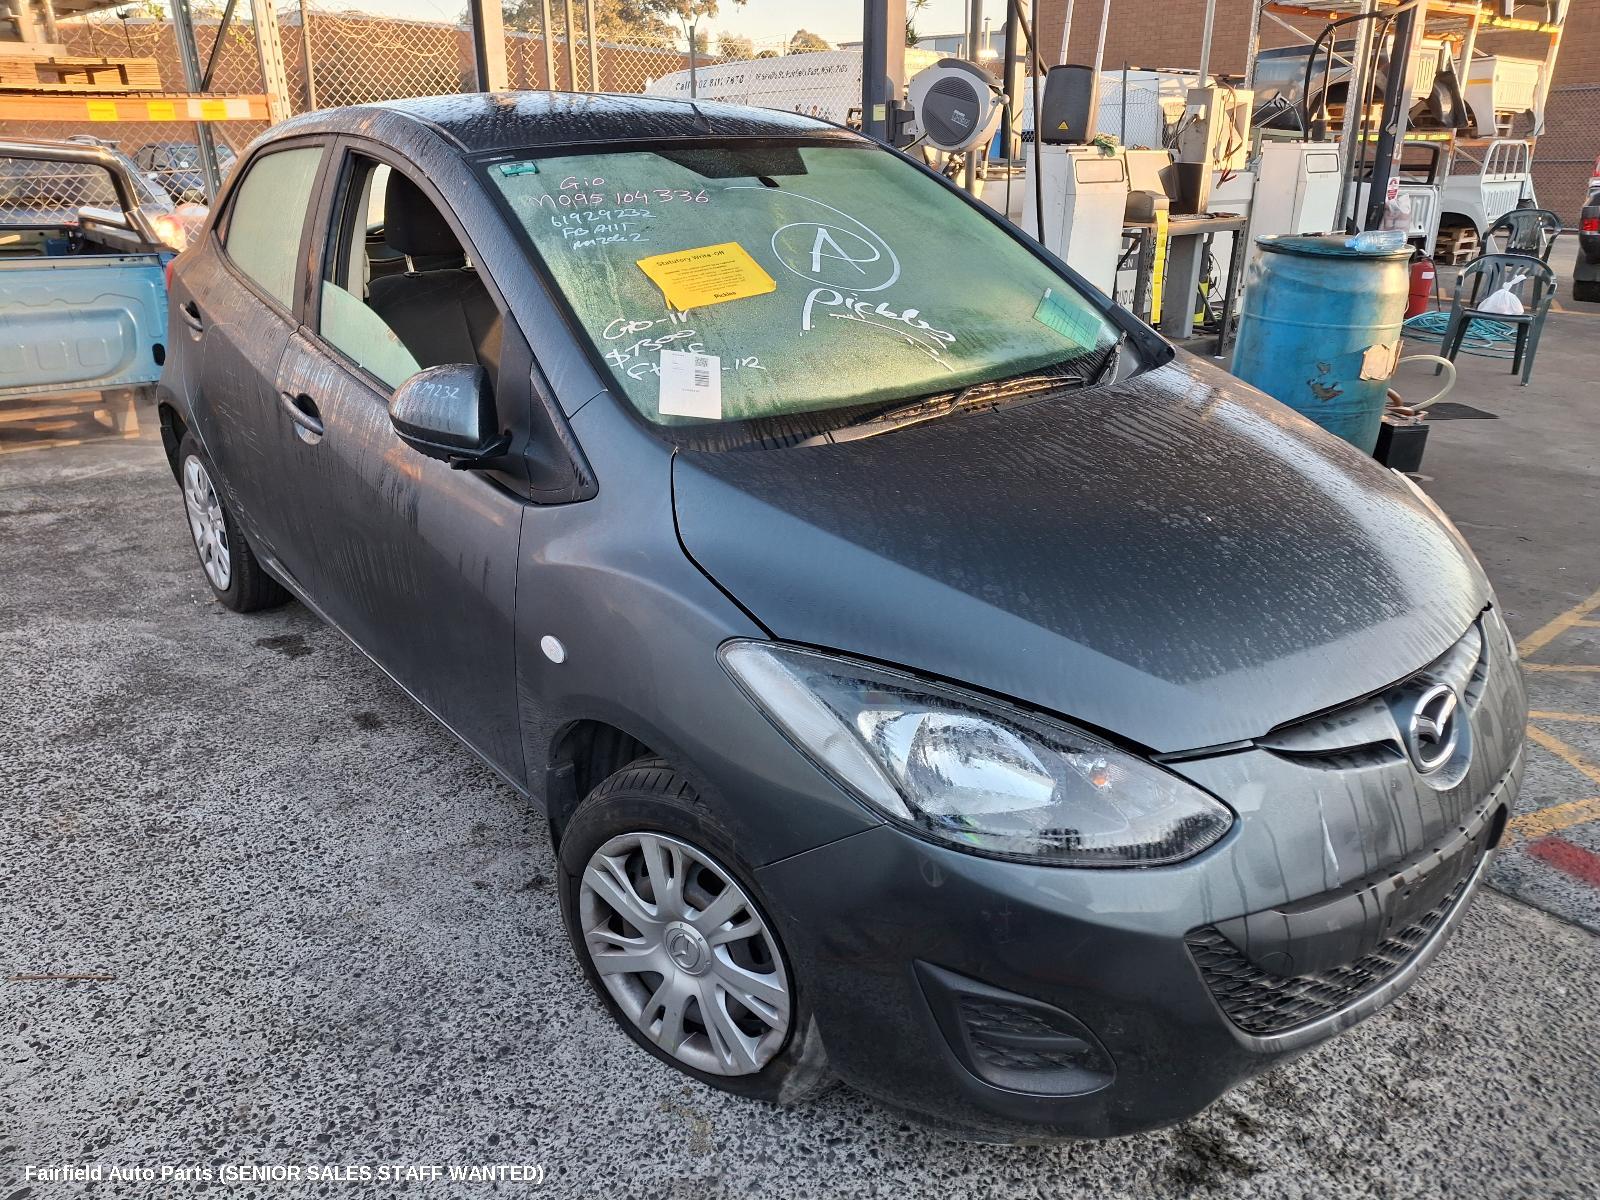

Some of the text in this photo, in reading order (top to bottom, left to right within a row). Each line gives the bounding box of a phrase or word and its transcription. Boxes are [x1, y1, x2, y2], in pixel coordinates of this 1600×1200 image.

[616, 190, 648, 205] 104
[653, 189, 709, 203] 336
[656, 256, 691, 267] Statutory
[714, 290, 737, 299] Pickles
